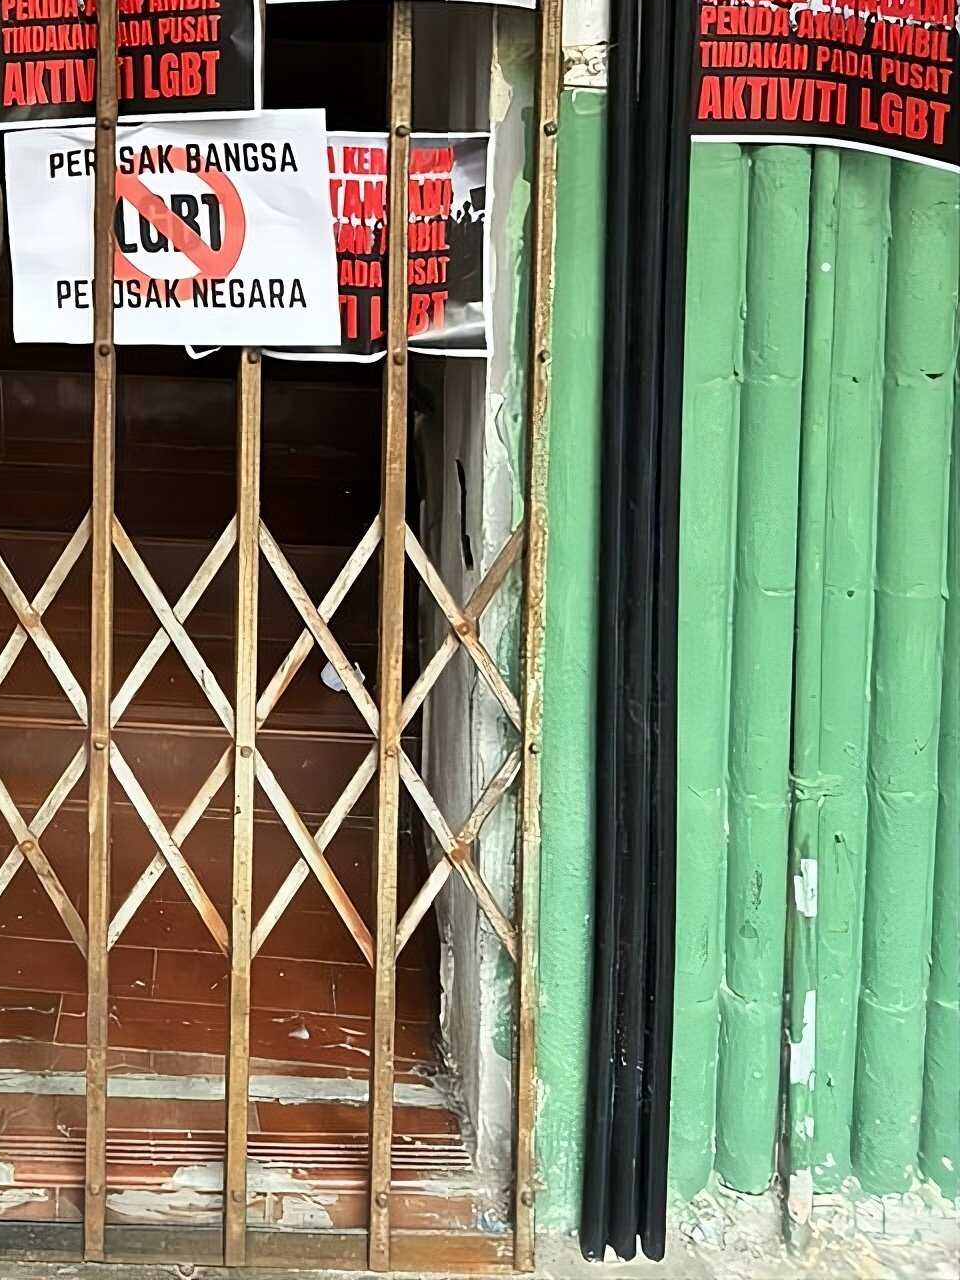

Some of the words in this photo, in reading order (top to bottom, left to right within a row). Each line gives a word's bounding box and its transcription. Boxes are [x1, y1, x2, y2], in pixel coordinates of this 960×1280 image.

[118, 19, 153, 49] ADA
[159, 15, 222, 45] PUSAT
[701, 6, 789, 37] PEKIDA
[797, 10, 867, 46] AKAN
[872, 20, 953, 62] AMBIL
[3, 55, 134, 107] AKTIVTI
[144, 50, 220, 98] LGBT
[700, 41, 809, 71] TINDAKAN
[816, 45, 873, 79] PADA
[881, 57, 953, 95] PUSAT
[698, 76, 847, 125] AKTIVITI
[860, 87, 951, 145] LGBT
[49, 144, 175, 178] PERSAK
[186, 143, 298, 173] BANGSA
[57, 279, 182, 309] PEOSAK
[192, 278, 307, 308] NEGARA
[340, 259, 382, 288] ADA
